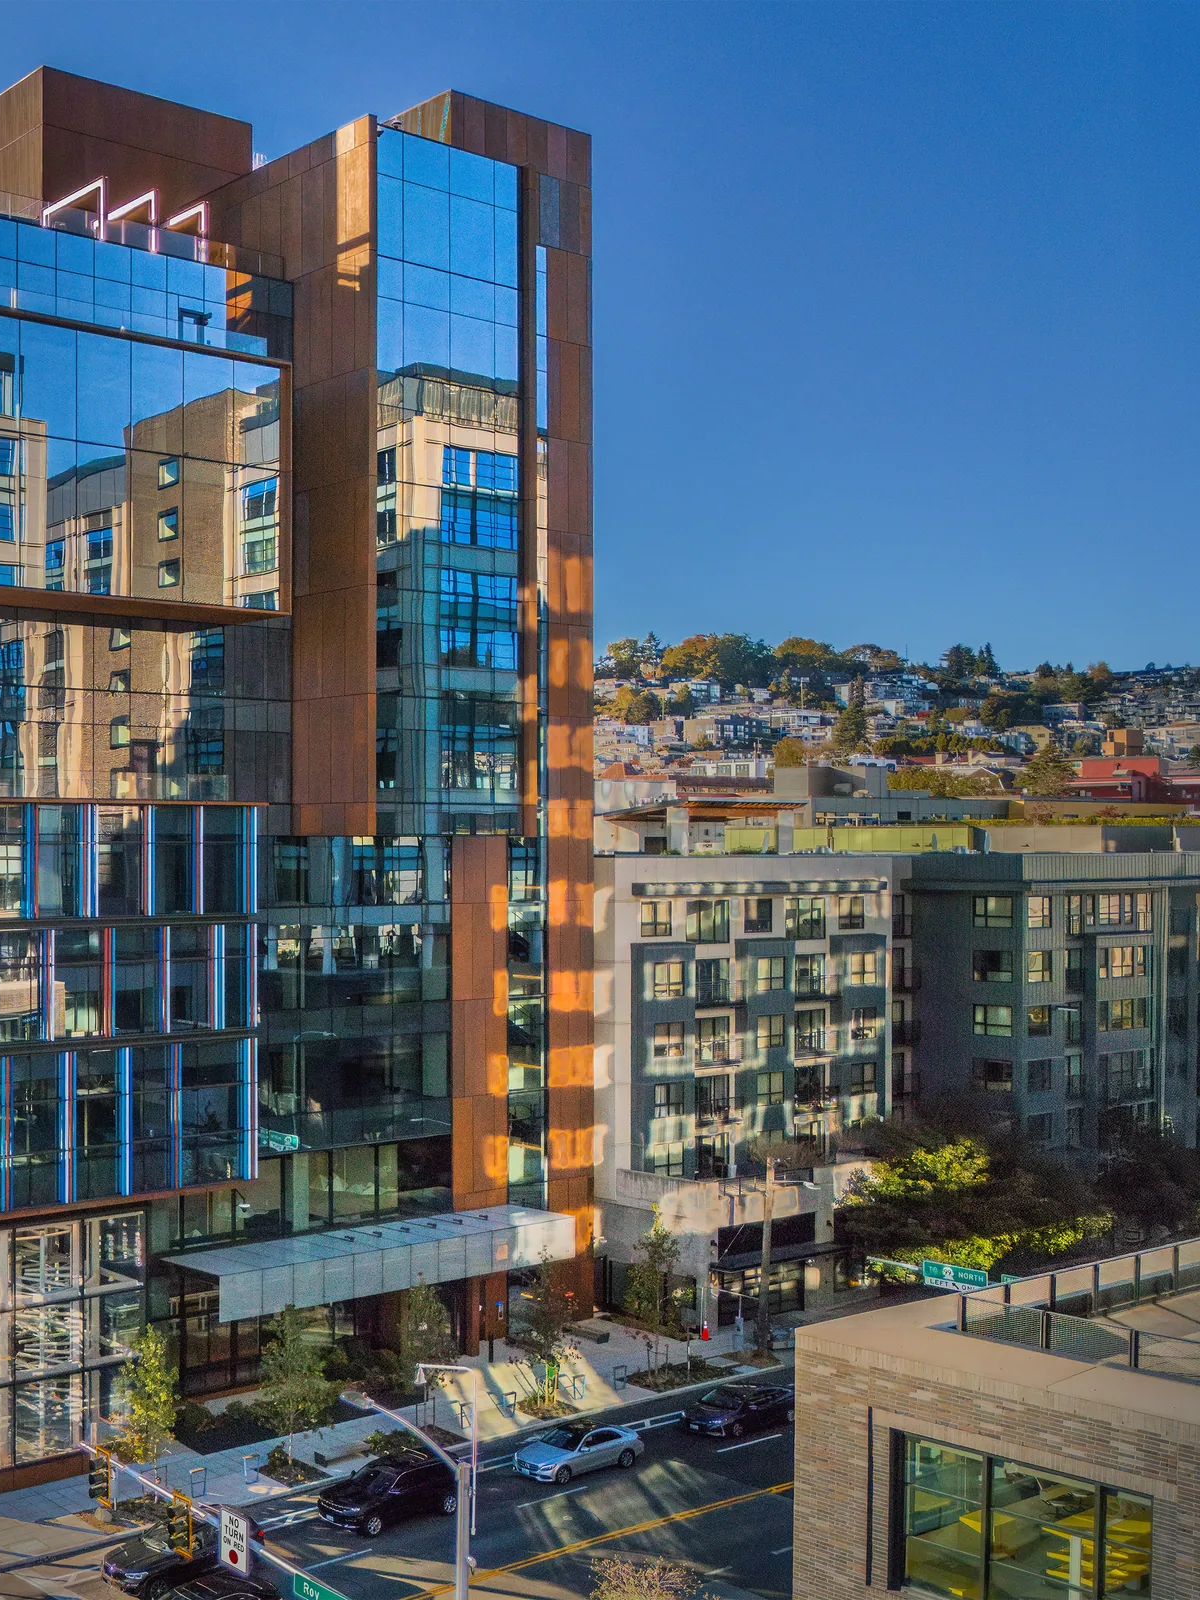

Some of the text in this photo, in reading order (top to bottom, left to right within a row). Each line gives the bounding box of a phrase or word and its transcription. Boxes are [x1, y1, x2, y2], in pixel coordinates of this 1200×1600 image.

[929, 1278, 949, 1287] LEFT
[958, 1272, 984, 1282] NORTH
[228, 1515, 240, 1529] NO
[224, 1525, 244, 1544] TURN
[223, 1535, 245, 1553] ON RED
[303, 1581, 320, 1600] Roy
